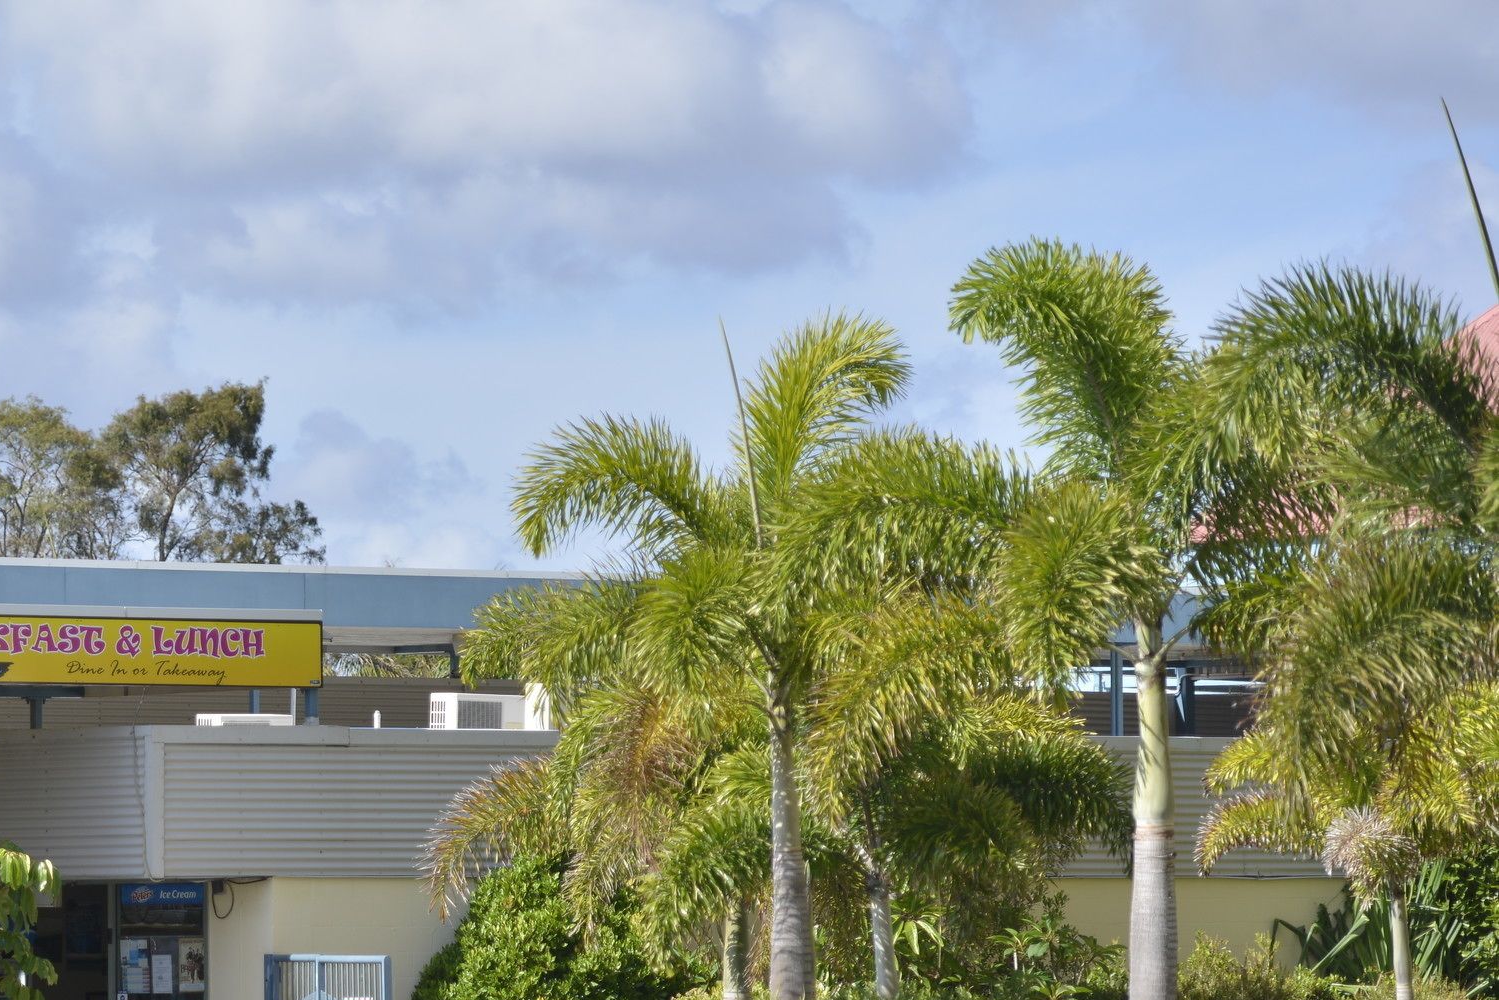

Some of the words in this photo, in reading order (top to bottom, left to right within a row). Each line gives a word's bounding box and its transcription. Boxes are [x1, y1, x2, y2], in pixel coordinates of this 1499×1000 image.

[115, 625, 142, 659] &
[66, 660, 104, 675] Dine
[110, 660, 128, 676] In
[132, 667, 148, 675] or
[159, 890, 171, 899] Ice
[172, 889, 197, 899] Cream
